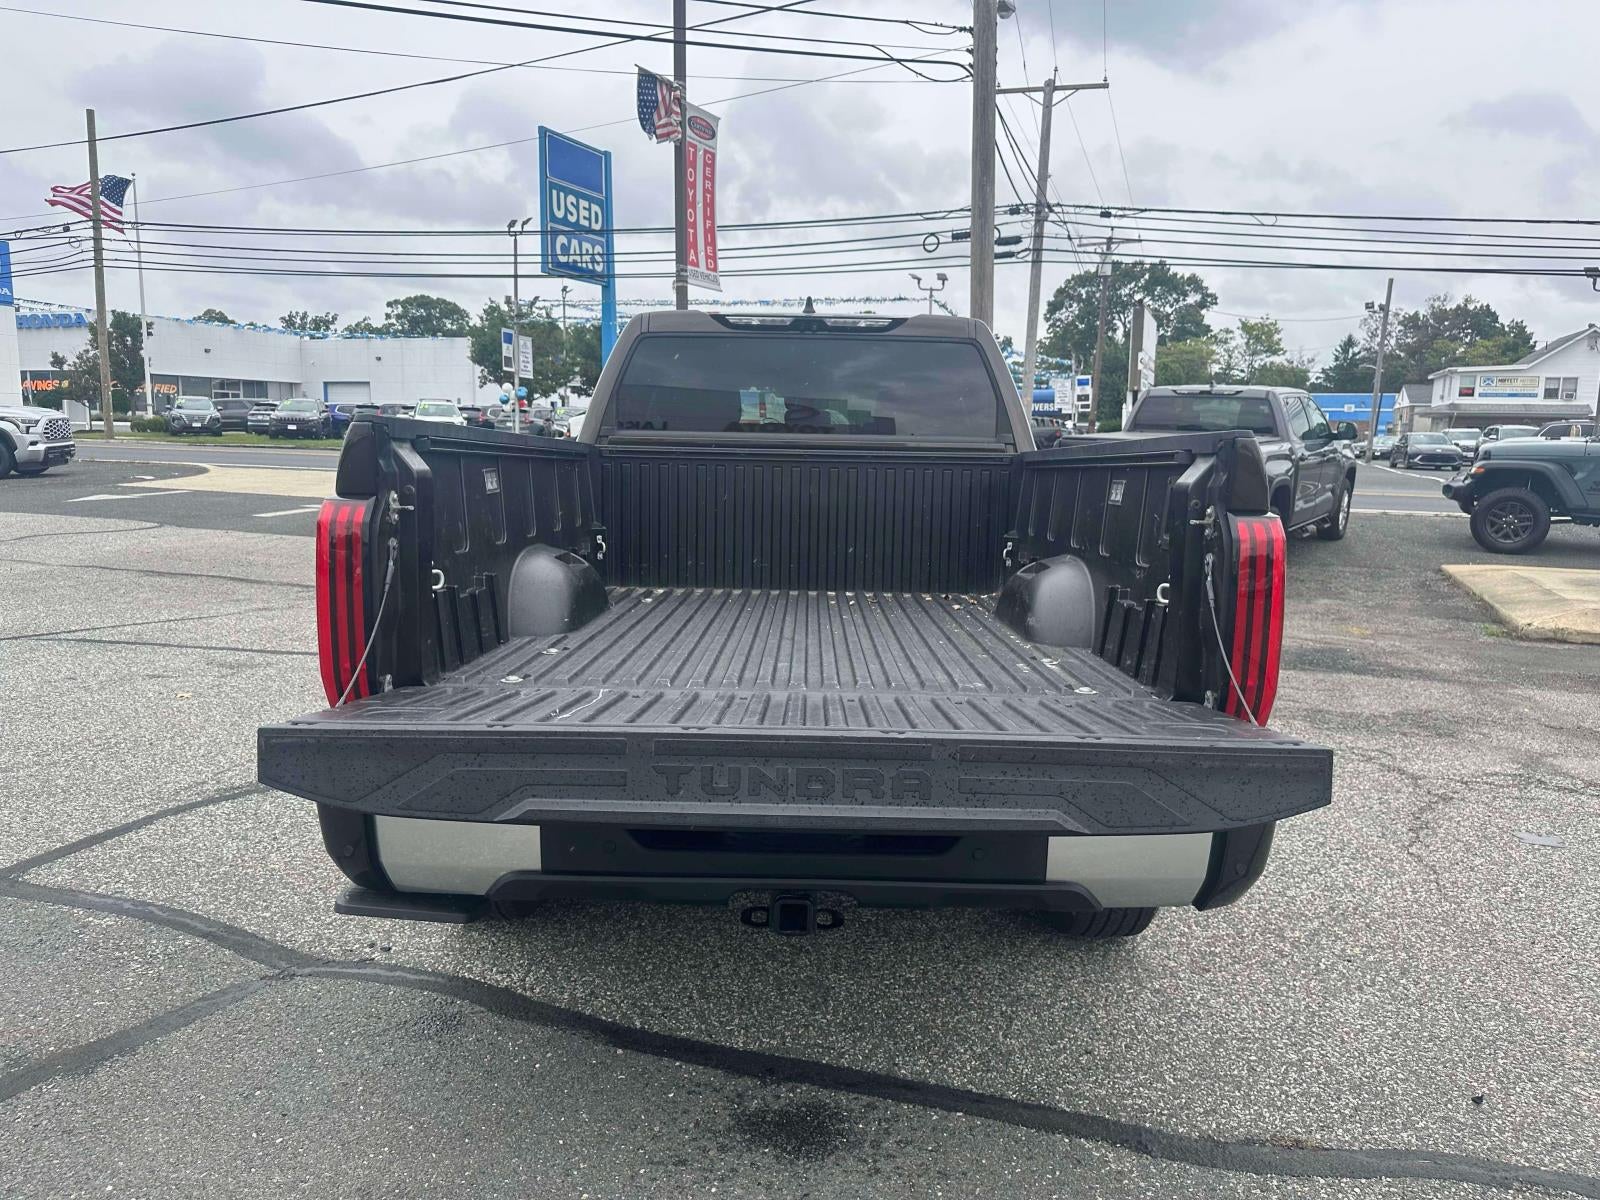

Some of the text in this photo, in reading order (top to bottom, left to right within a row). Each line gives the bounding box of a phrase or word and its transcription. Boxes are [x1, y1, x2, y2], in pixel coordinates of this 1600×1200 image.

[551, 189, 603, 231] USED
[687, 147, 697, 263] TOYOTA
[704, 153, 715, 268] CERTIFIED
[555, 234, 604, 272] CARS
[16, 312, 88, 329] HONDA
[21, 379, 60, 391] AVINGS
[652, 764, 932, 800] TUNDRA
